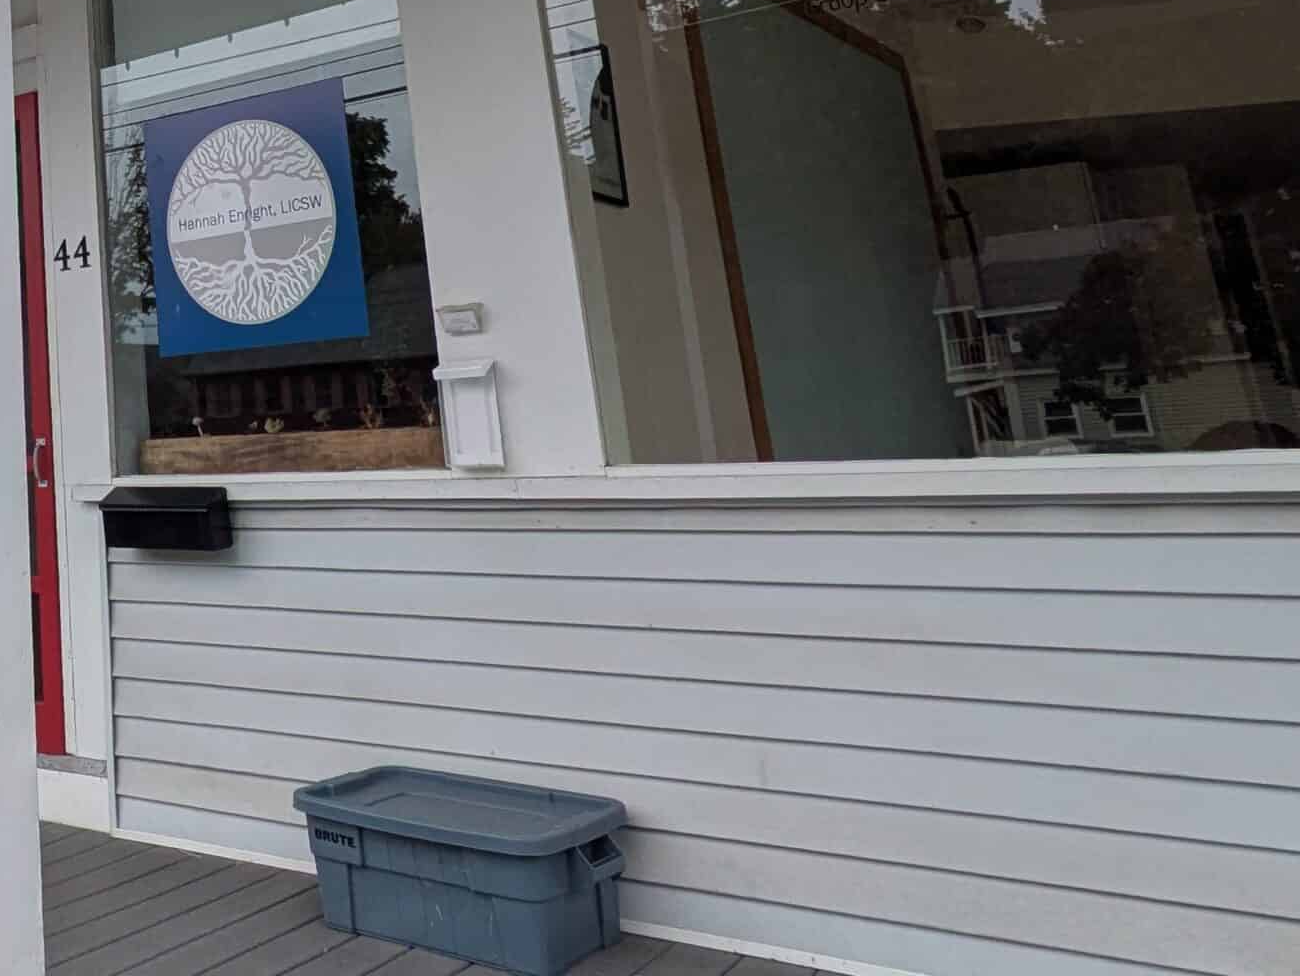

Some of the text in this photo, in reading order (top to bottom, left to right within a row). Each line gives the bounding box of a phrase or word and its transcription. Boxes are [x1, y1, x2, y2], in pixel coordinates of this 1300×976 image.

[178, 212, 226, 233] Hannah
[280, 194, 323, 215] LICSW
[53, 235, 92, 272] 44
[314, 828, 357, 849] BRUTE
